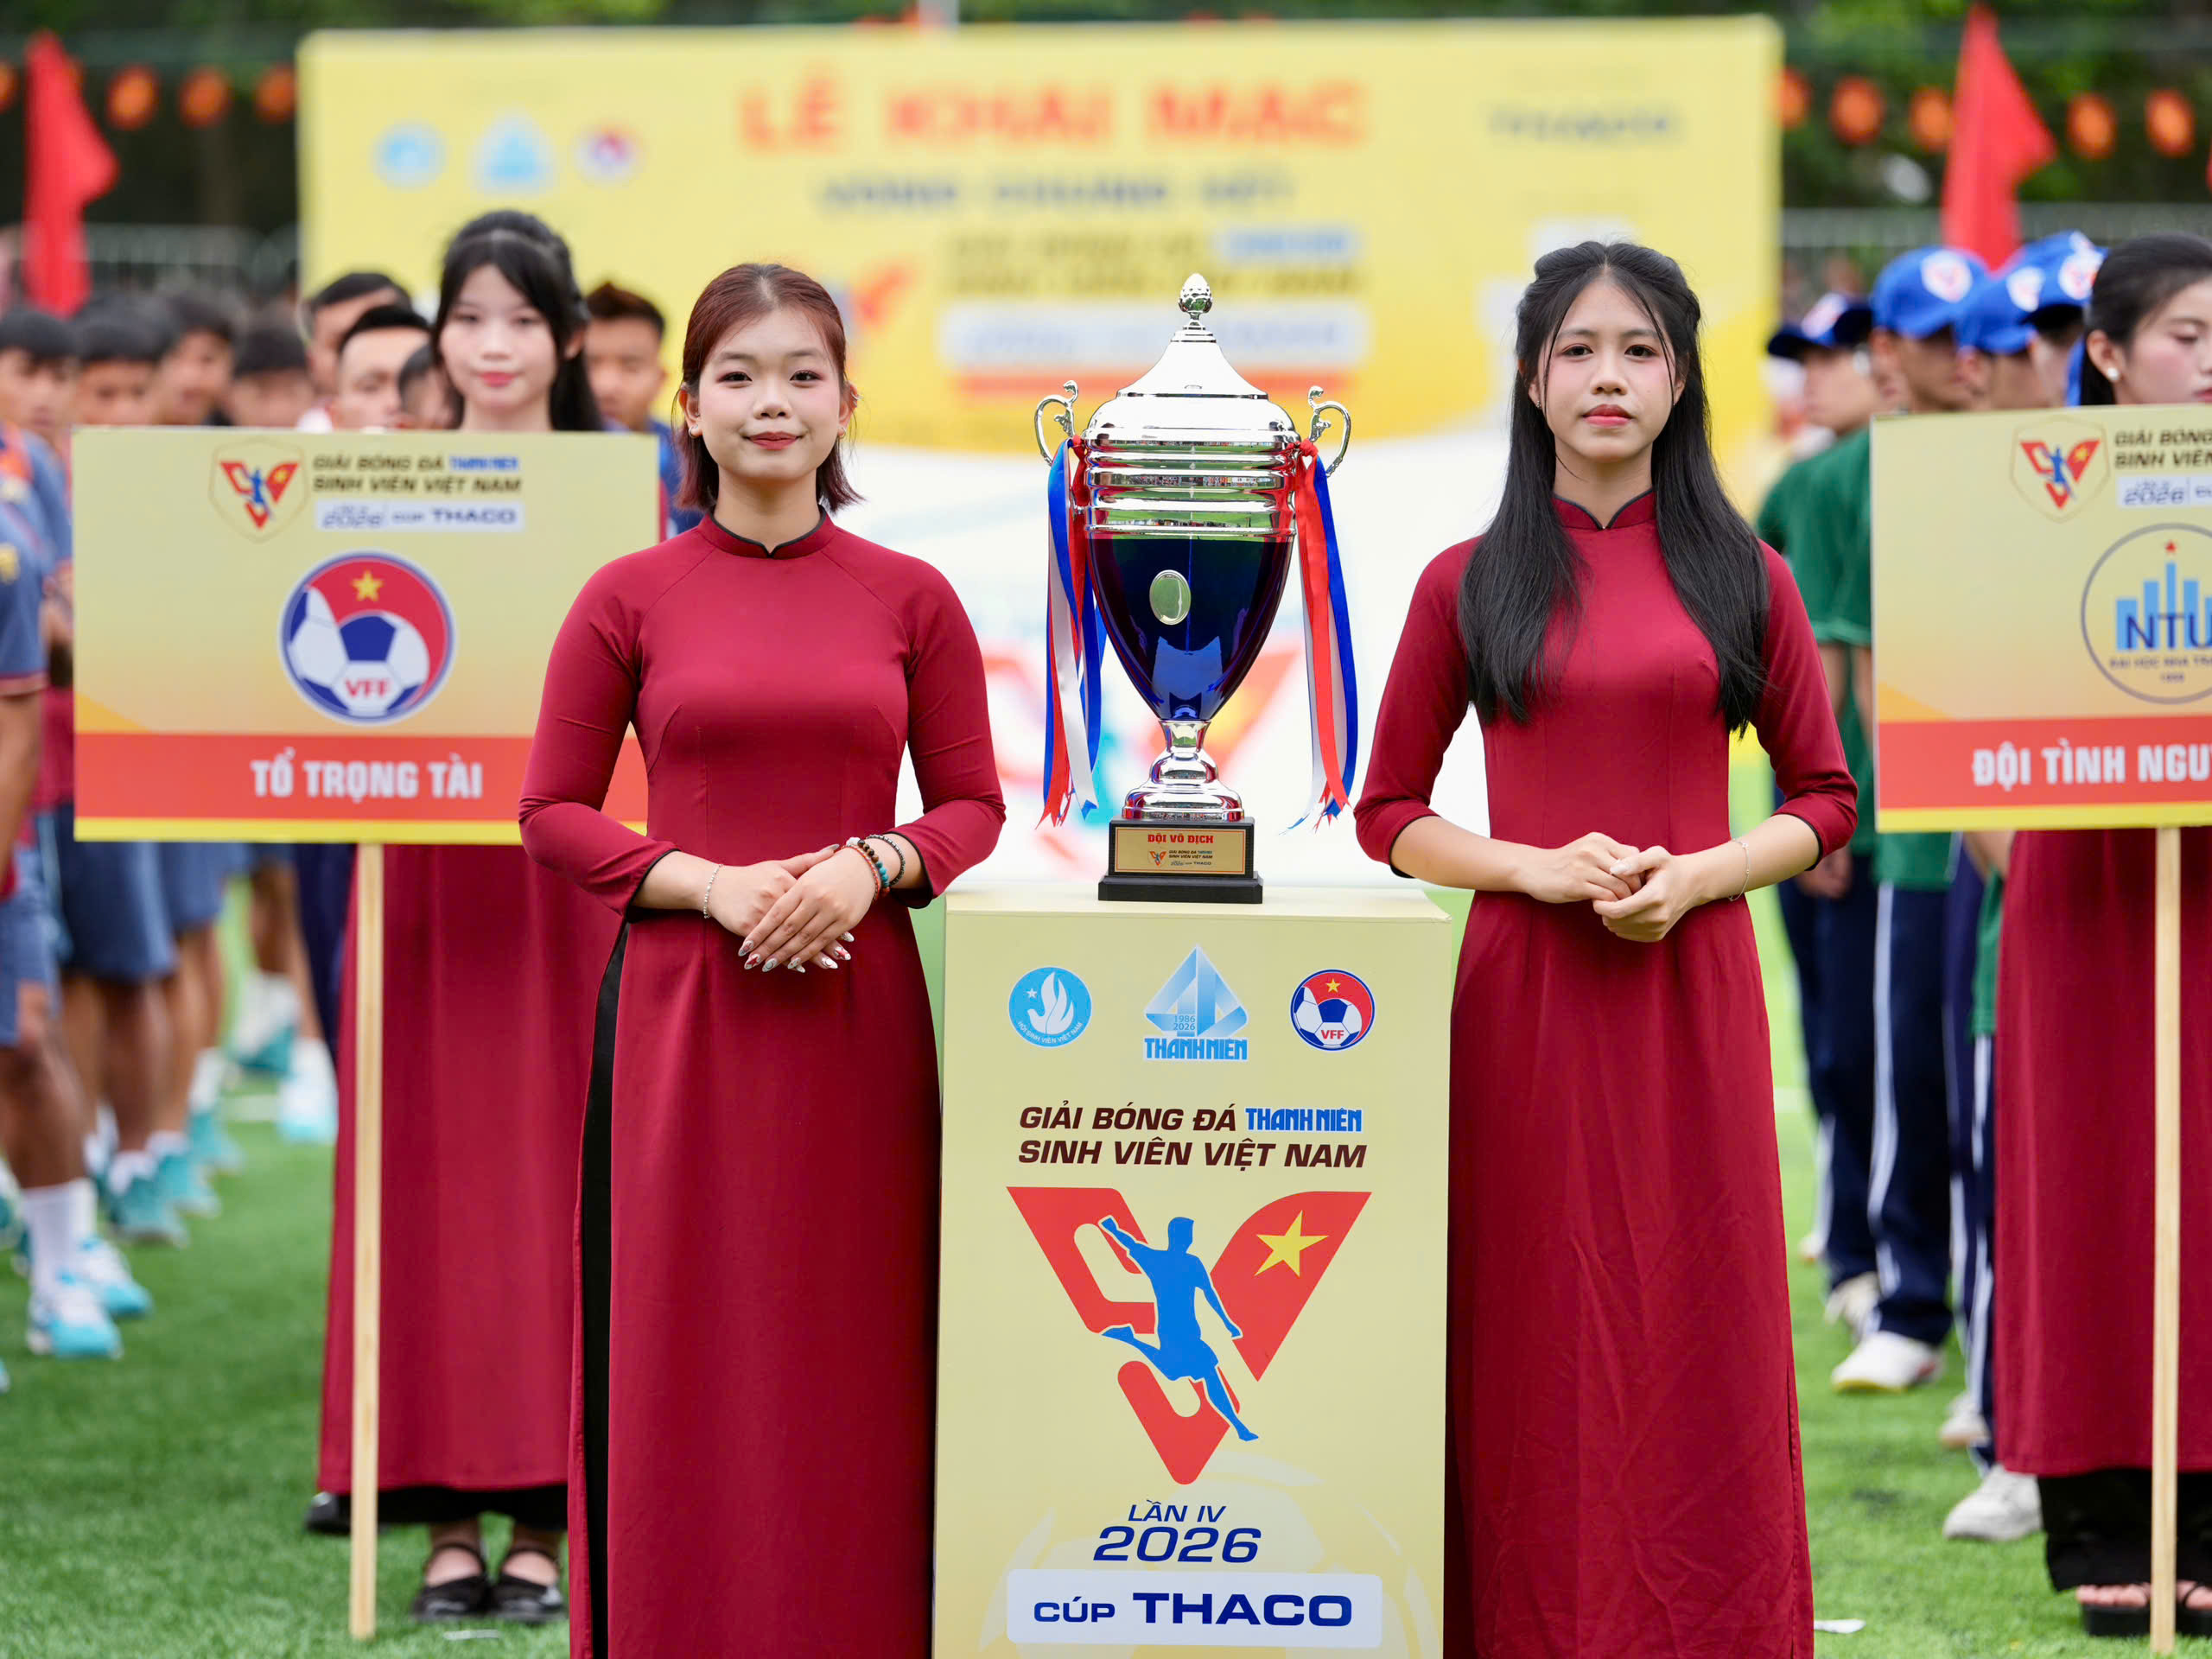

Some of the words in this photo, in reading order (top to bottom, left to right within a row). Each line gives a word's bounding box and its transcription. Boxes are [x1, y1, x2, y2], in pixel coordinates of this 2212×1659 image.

[345, 679, 390, 696] VFF
[251, 747, 296, 798] TỔ
[303, 762, 419, 803] TRỌNG
[427, 753, 483, 798] TÀI
[1972, 741, 2031, 791] ĐỘI
[2041, 737, 2126, 785] TÌNH
[2137, 742, 2212, 783] NGU
[1174, 1014, 1196, 1023] 1986
[1321, 1029, 1344, 1039] VFF
[1020, 1100, 1083, 1129] GIẢI
[1092, 1102, 1184, 1131] BÓNG
[1192, 1104, 1236, 1132] ĐÁ
[1246, 1108, 1313, 1131] THANH
[1019, 1140, 1102, 1164] SINH
[1114, 1137, 1192, 1166] VIÊN
[1204, 1138, 1275, 1172] VIỆT
[1284, 1144, 1367, 1168] NAM
[1128, 1500, 1187, 1522] LẦN
[1197, 1506, 1226, 1522] IV
[1093, 1526, 1262, 1563] 2026
[1033, 1597, 1116, 1623] CÚP
[1133, 1592, 1352, 1627] THACO
